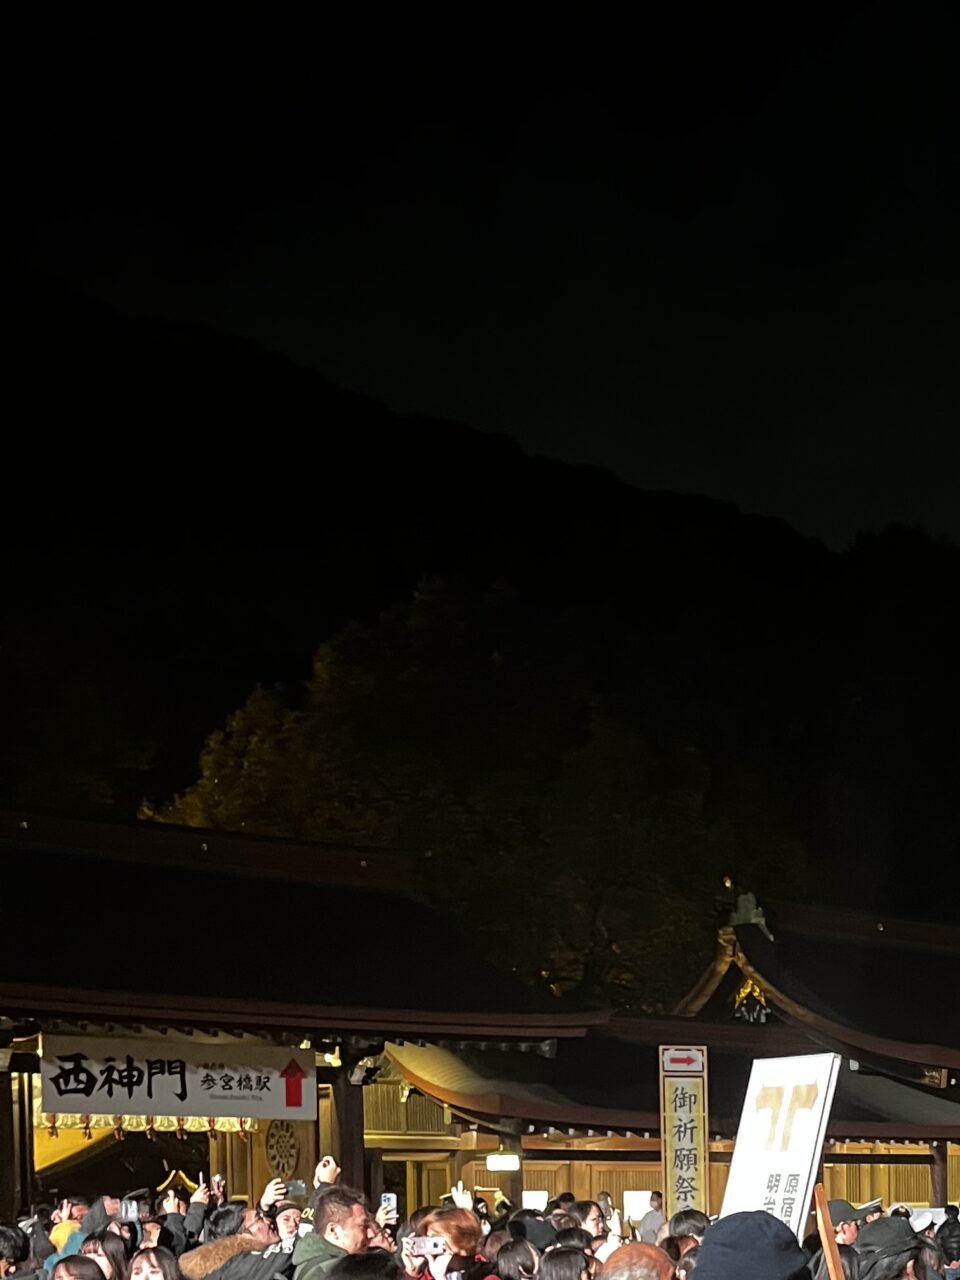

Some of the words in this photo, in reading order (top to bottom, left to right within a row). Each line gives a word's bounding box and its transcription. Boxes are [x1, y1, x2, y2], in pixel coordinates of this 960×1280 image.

[49, 1052, 187, 1102] 西神門
[200, 1073, 271, 1091] 参宮橋駅
[671, 1086, 699, 1209] 御祈願祭
